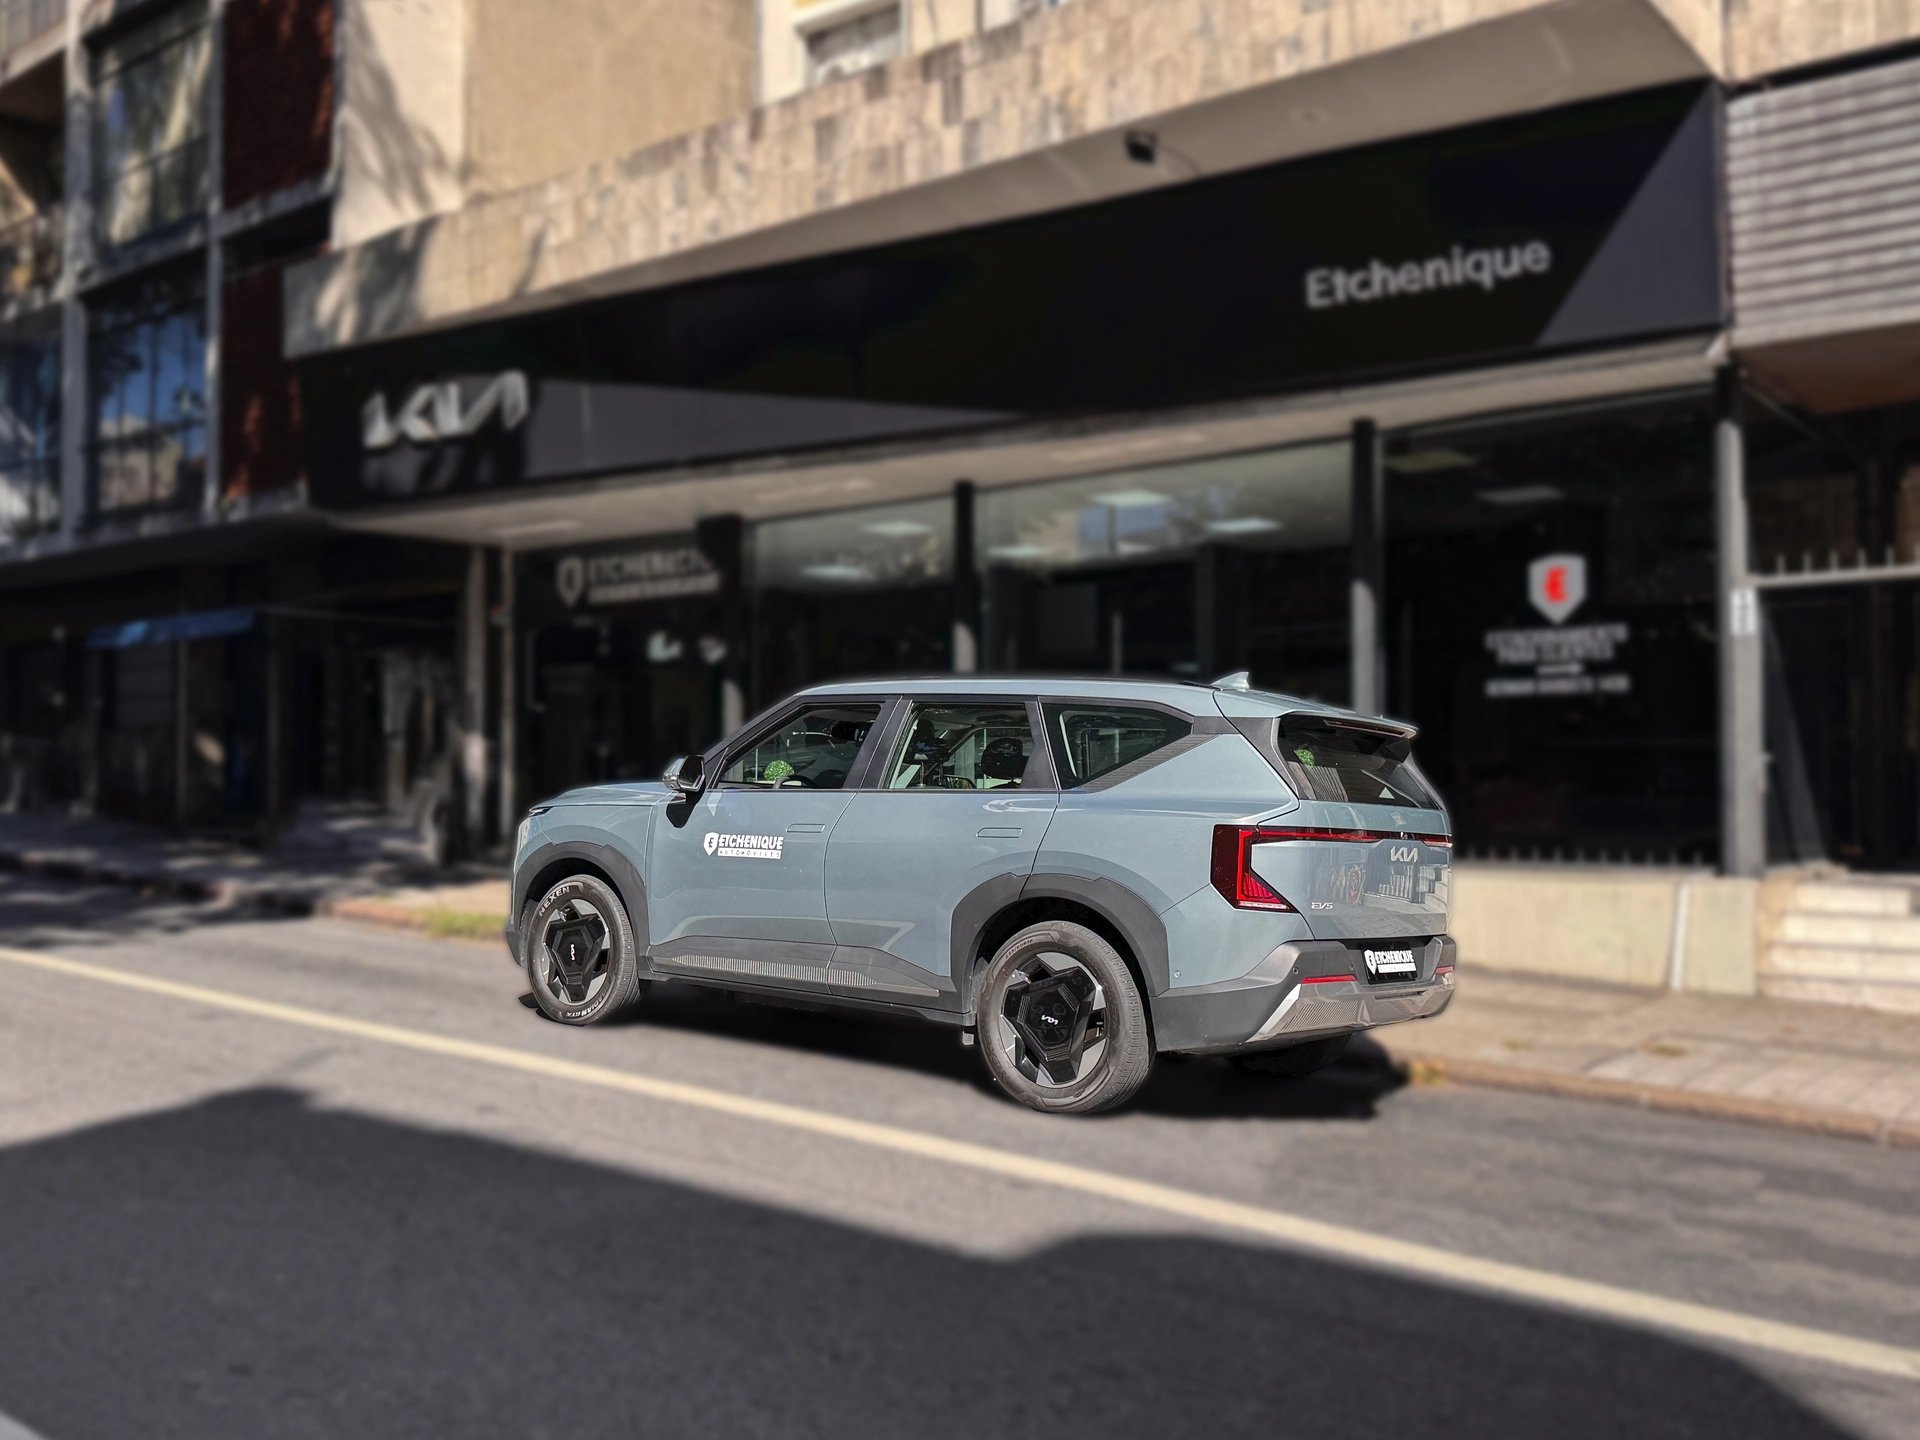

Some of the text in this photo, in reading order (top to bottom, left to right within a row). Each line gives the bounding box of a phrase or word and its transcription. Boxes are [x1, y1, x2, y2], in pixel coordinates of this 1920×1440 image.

[1305, 241, 1552, 309] Etchenique
[362, 369, 528, 448] KIA
[719, 834, 784, 849] ETCHENIQUE
[719, 850, 780, 858] AUTOMOVILES
[1390, 846, 1418, 863] KIA
[538, 886, 570, 917] NEXEN
